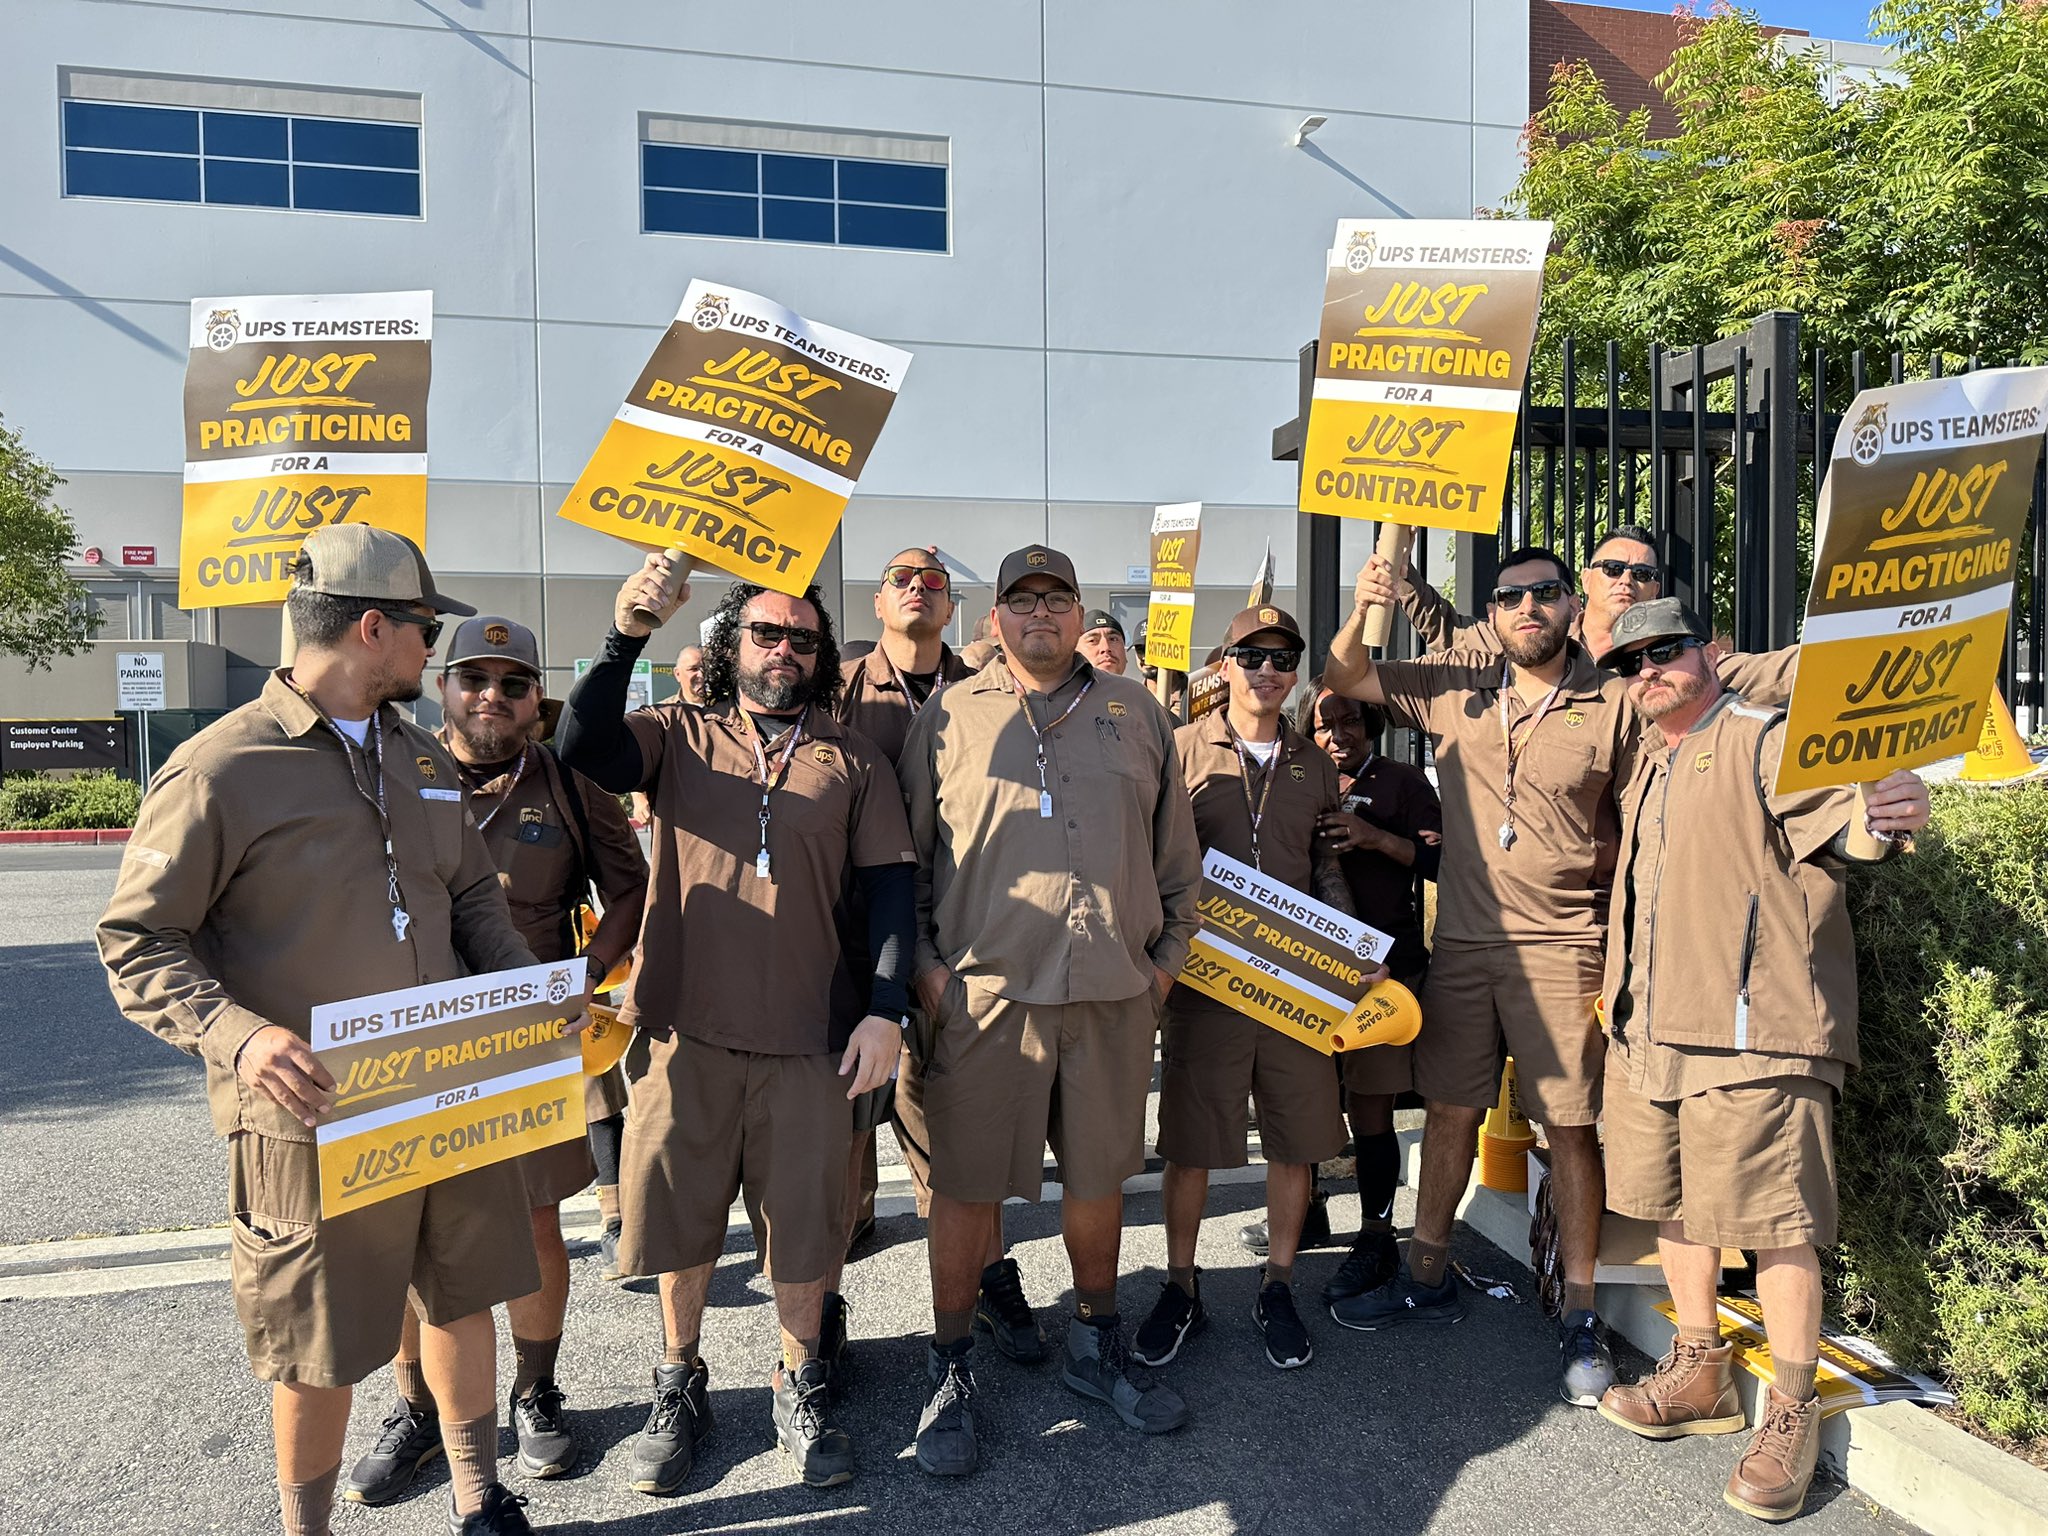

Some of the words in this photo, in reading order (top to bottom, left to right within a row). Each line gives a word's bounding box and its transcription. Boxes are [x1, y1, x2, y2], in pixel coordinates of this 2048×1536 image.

[1379, 246, 1414, 263] UPS
[1419, 247, 1532, 265] TEAMSTERS:
[1364, 280, 1489, 326] JUST
[245, 321, 286, 338] UPS
[292, 319, 420, 337] TEAMSTERS:
[730, 312, 769, 333] UPS
[773, 325, 890, 384] TEAMSTERS:
[1328, 342, 1512, 379] PRACTICING
[235, 353, 377, 397] JUST
[703, 347, 842, 401] JUST
[1384, 387, 1417, 402] FOR
[1419, 389, 1432, 403] A
[201, 414, 411, 449] PRACTICING
[645, 379, 853, 466] PRACTICING
[1347, 414, 1465, 459] JUST
[1890, 419, 1934, 446] UPS
[1937, 406, 2041, 441] TEAMSTERS:
[705, 429, 746, 452] FOR
[746, 442, 764, 457] A
[271, 457, 310, 472] FOR
[315, 456, 329, 471] A
[646, 449, 792, 507] JUST
[232, 485, 371, 533] JUST
[1315, 469, 1487, 513] CONTRACT
[1880, 459, 2008, 532] JUST
[589, 486, 802, 574] CONTRACT
[1156, 538, 1185, 561] JUST
[1825, 537, 2011, 600] PRACTICING
[198, 552, 298, 587] CONT
[1153, 609, 1180, 632] JUST
[1898, 607, 1937, 628] FOR
[1937, 604, 1951, 622] A
[134, 657, 148, 667] NO
[1148, 640, 1185, 660] CONTRACT
[1846, 633, 1973, 704] JUST
[120, 669, 162, 679] PARKING
[10, 725, 49, 735] Customer
[51, 725, 78, 735] Center
[10, 740, 51, 750] Employee
[52, 739, 84, 750] Parking
[1798, 700, 1977, 769] CONTRACT
[1995, 739, 2004, 757] UPS
[1210, 864, 1247, 890] UPS
[1249, 882, 1352, 944] TEAMSTERS:
[1196, 895, 1258, 929] JUST
[1253, 922, 1363, 987] PRACTICING
[1247, 955, 1273, 973] FOR
[1269, 966, 1280, 977] A
[330, 1012, 384, 1042] UPS
[389, 982, 539, 1029] TEAMSTERS:
[1184, 953, 1231, 980] UST
[1227, 976, 1332, 1036] CONTRACT
[1357, 1012, 1383, 1034] GAME
[336, 1046, 422, 1095] JUST
[435, 1090, 467, 1109] FOR
[467, 1086, 480, 1102] A
[1508, 1077, 1516, 1107] GAME
[341, 1134, 426, 1188] JUST
[429, 1097, 568, 1159] CONTRACT
